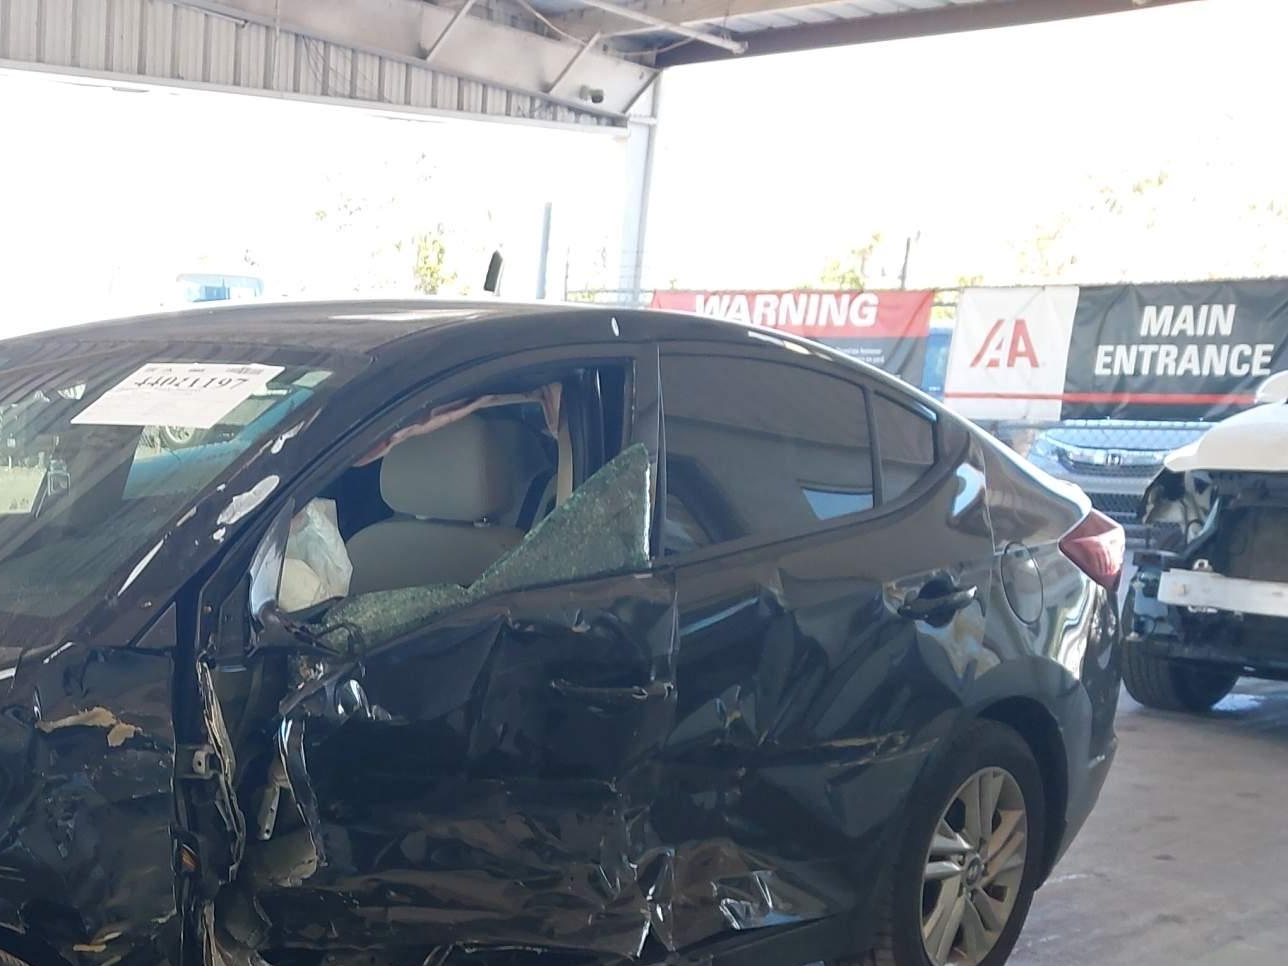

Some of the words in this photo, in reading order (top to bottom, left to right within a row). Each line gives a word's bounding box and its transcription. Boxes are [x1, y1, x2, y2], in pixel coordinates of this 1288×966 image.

[695, 293, 879, 327] WARNING
[1140, 303, 1236, 337] MAIN
[1094, 343, 1275, 377] ENTRANCE
